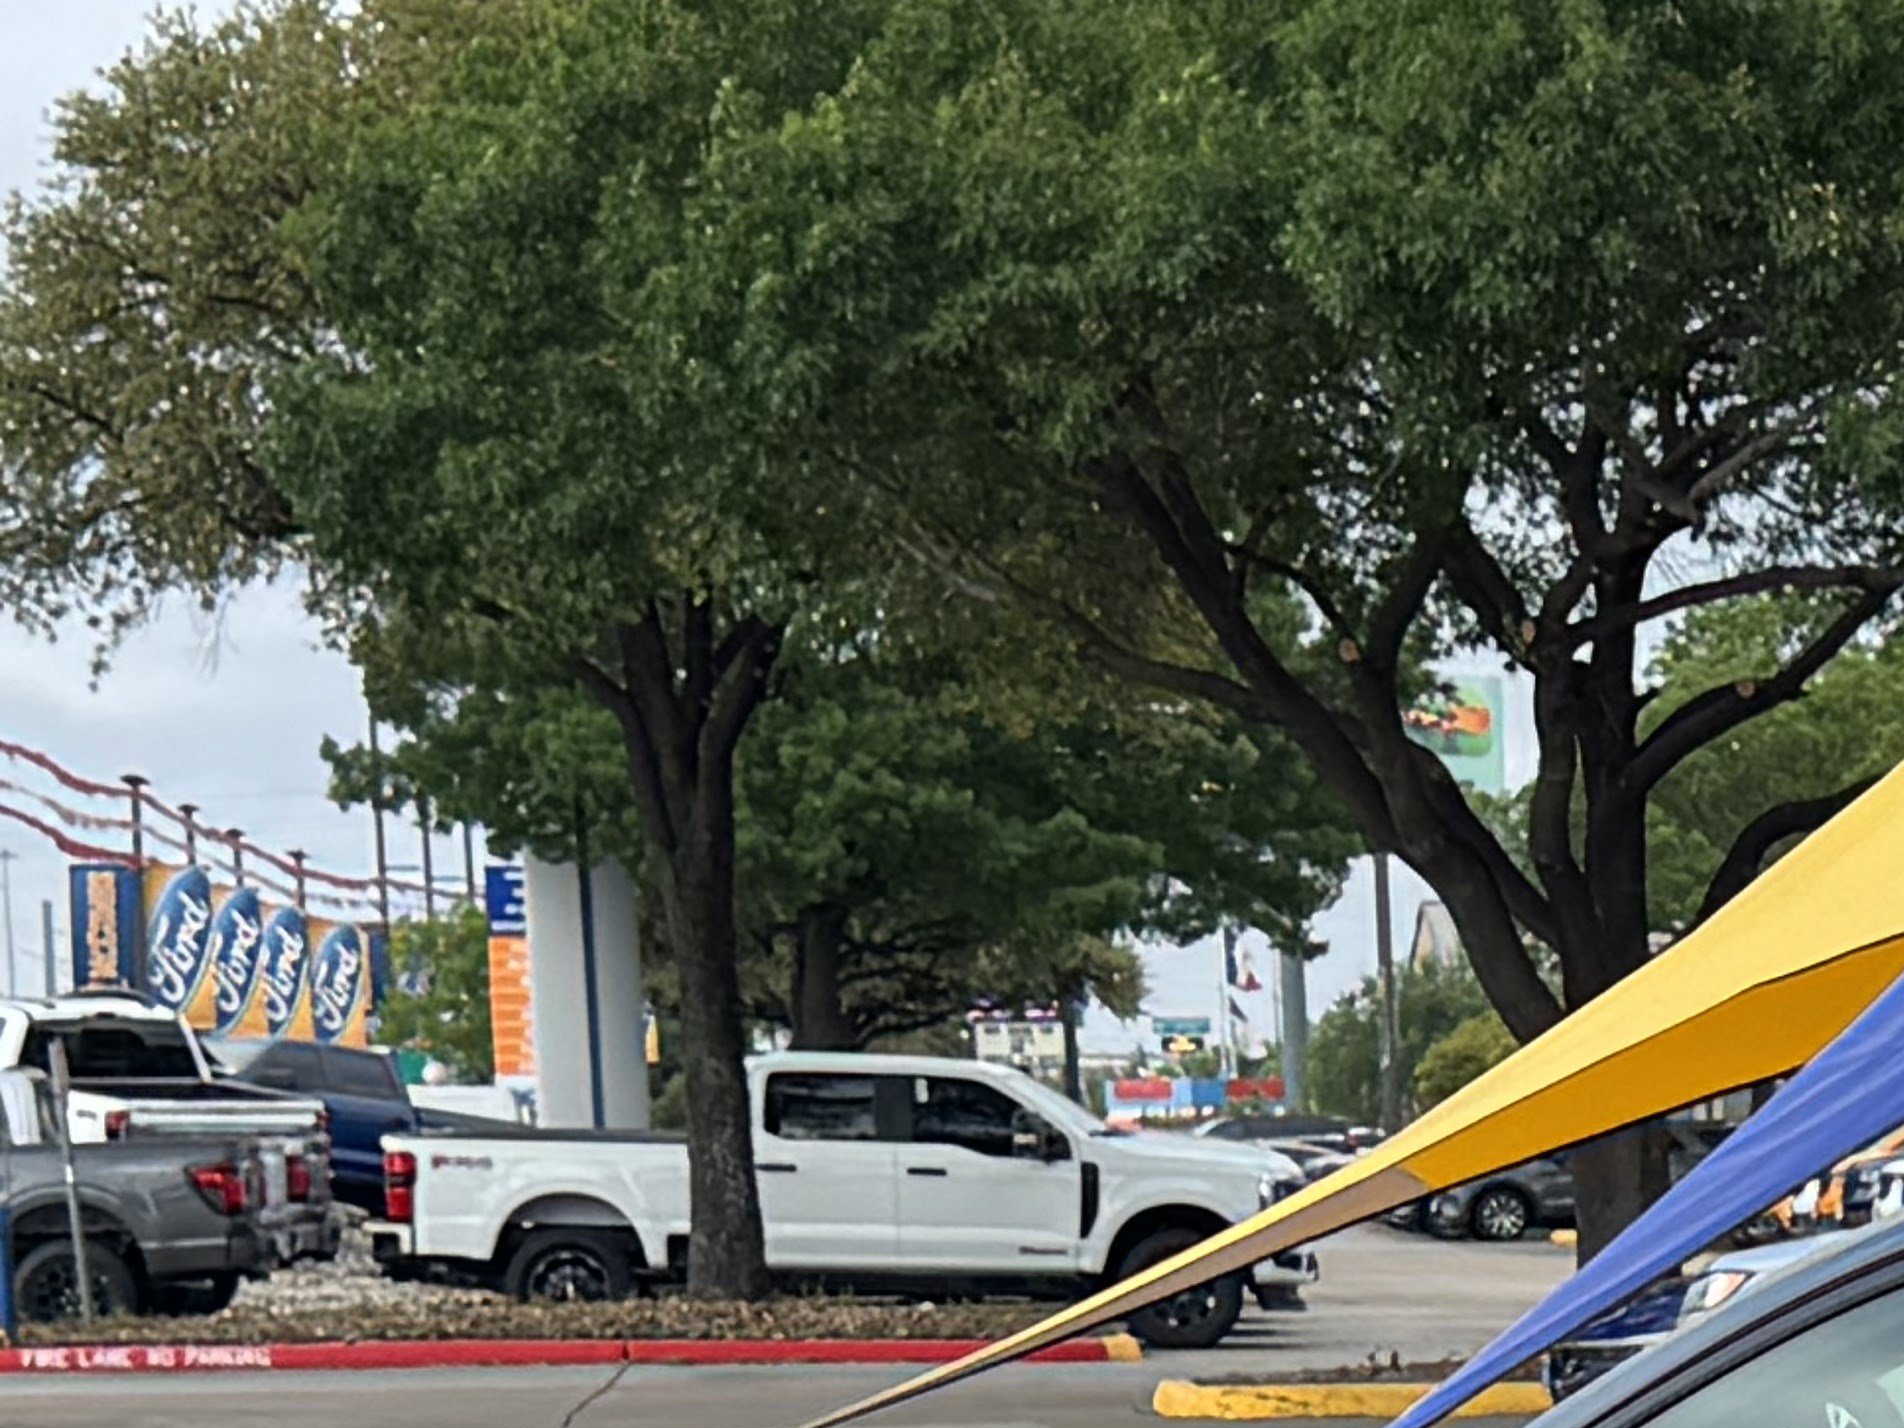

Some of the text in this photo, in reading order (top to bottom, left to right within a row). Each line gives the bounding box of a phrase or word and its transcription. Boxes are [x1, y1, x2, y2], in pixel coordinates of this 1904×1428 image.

[149, 892, 209, 1003] Ford
[214, 909, 261, 1013] Ford
[262, 925, 304, 1022] Ford
[315, 943, 357, 1031] Ford
